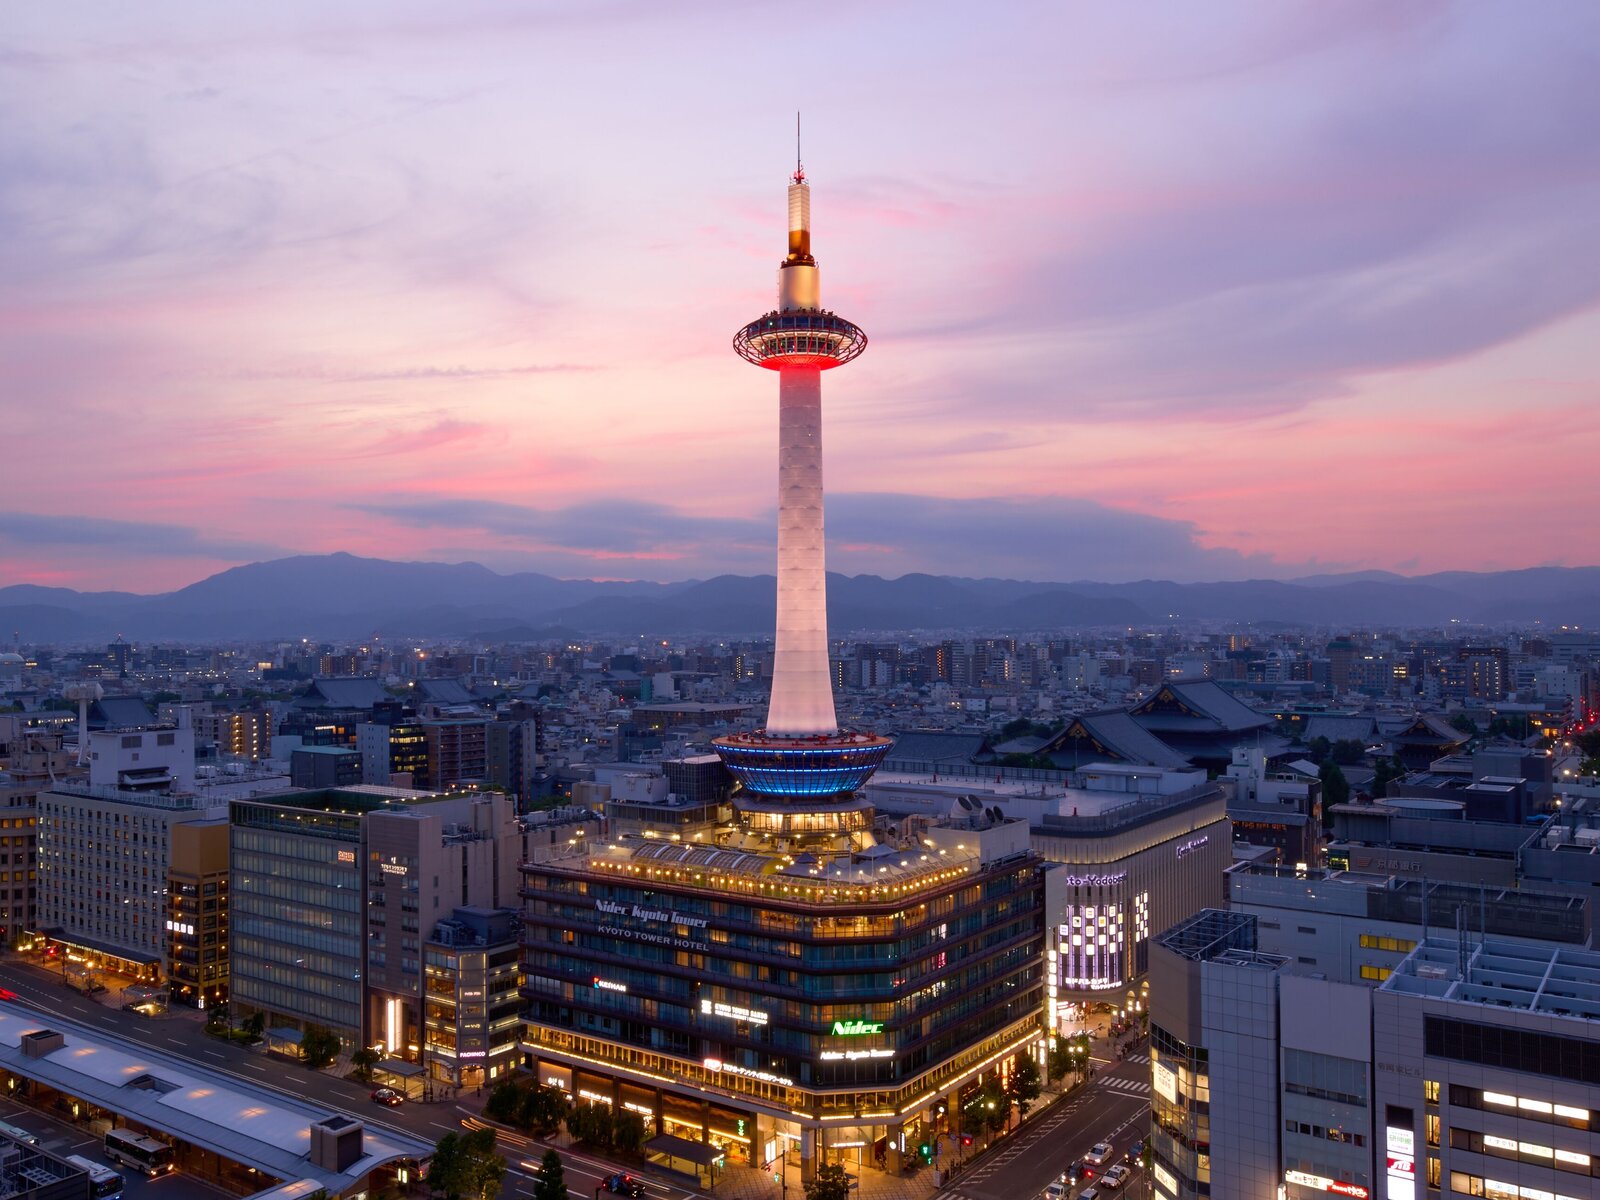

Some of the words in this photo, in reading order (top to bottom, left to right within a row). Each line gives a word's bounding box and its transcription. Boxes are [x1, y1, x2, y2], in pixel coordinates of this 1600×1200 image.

[594, 899, 629, 915] Nidec
[632, 905, 669, 922] Kyoto
[670, 911, 710, 928] Tower
[598, 925, 631, 938] KYOTO
[634, 931, 670, 945] TOWER
[674, 939, 709, 952] HOTEL
[831, 1020, 884, 1036] Nidec
[1390, 1160, 1411, 1171] JTB
